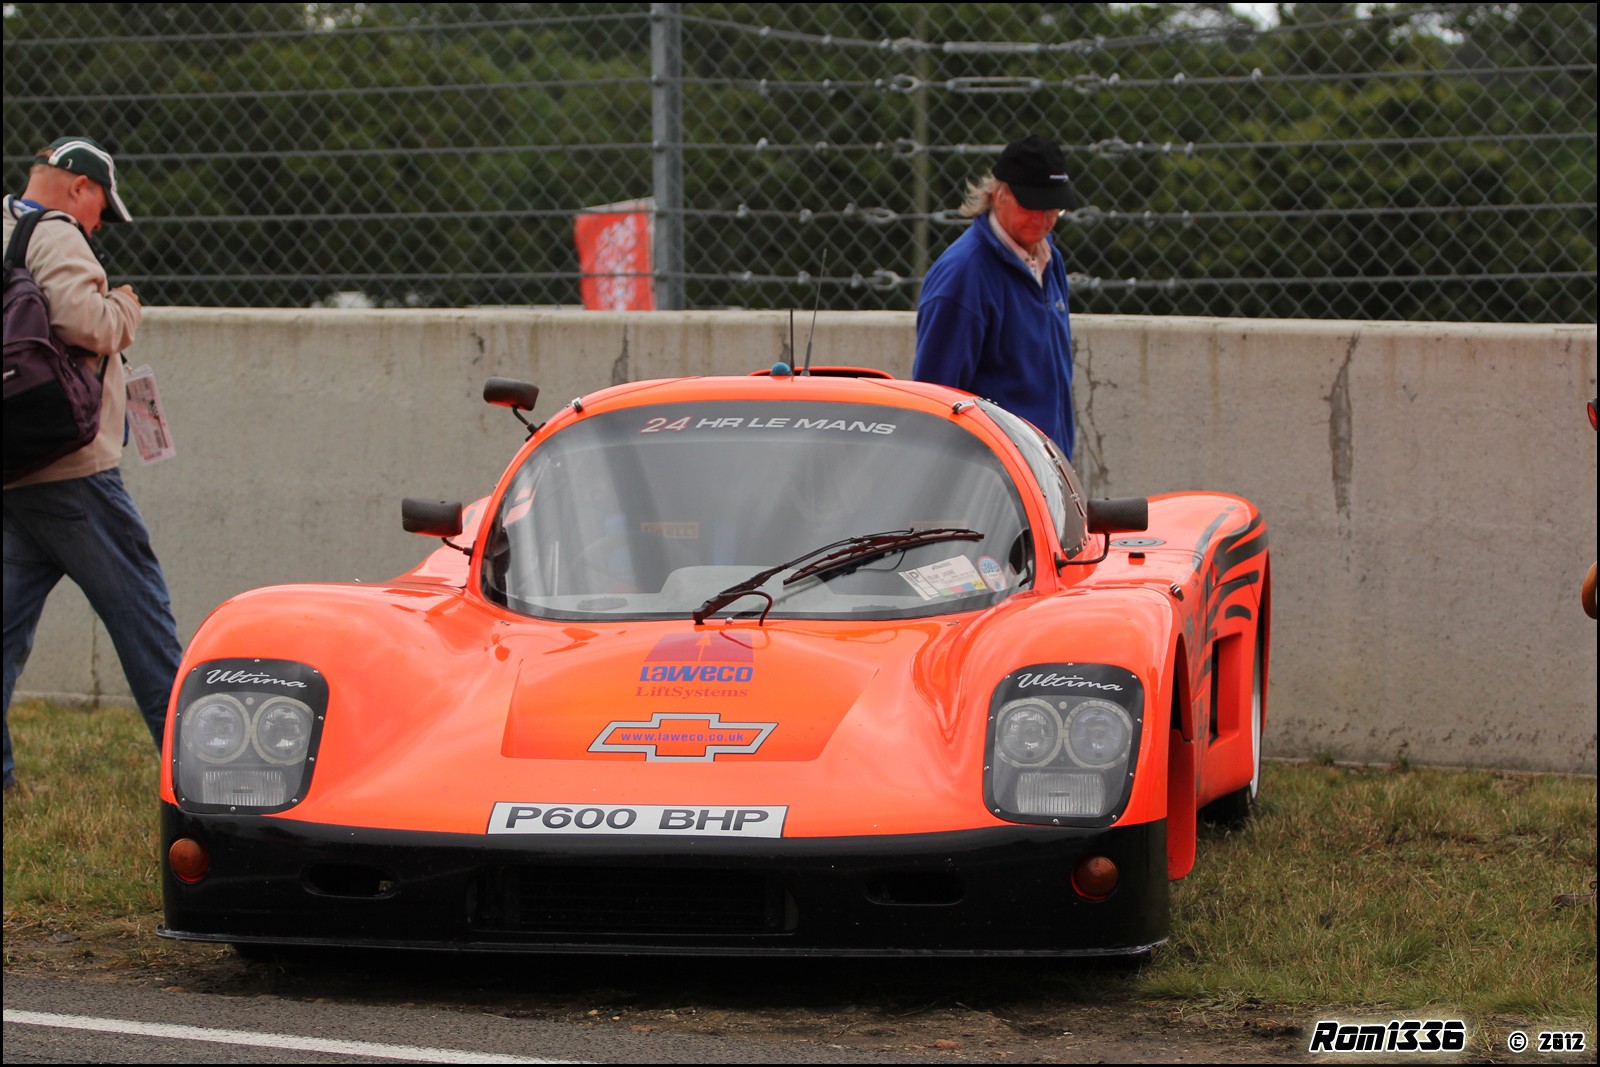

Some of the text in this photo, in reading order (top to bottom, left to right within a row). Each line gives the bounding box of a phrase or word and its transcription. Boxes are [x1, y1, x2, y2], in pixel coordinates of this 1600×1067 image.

[639, 416, 897, 435] 24 HR LE MANS
[206, 669, 308, 688] Ultima
[1017, 673, 1124, 691] Ultima
[634, 686, 749, 699] LiftSystems
[621, 732, 744, 742] www.laweco.co.uk
[505, 806, 770, 831] P600 BHP
